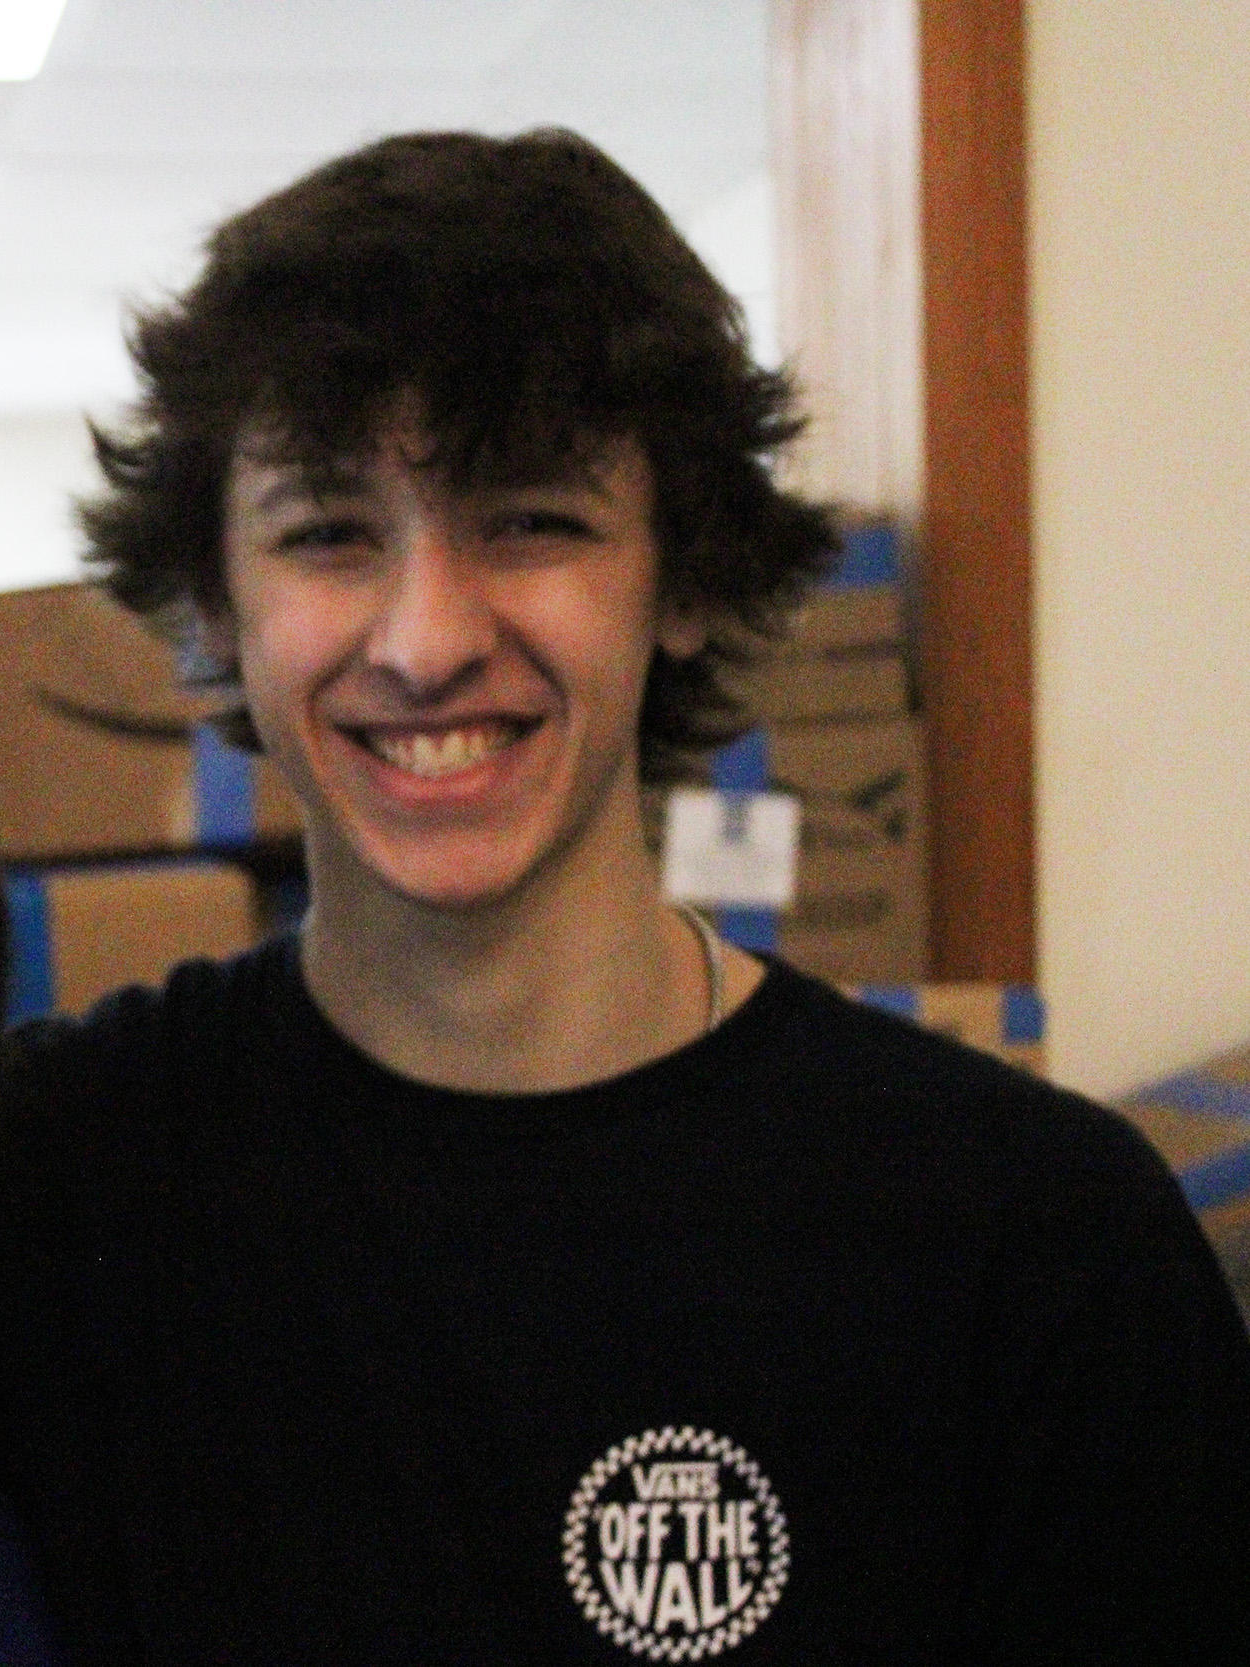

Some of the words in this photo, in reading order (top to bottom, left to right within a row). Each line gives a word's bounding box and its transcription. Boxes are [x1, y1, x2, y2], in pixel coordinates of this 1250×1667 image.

[631, 1462, 720, 1499] VANS
[601, 1502, 672, 1560] OFF
[678, 1501, 758, 1561] THE
[600, 1559, 754, 1633] WALL
